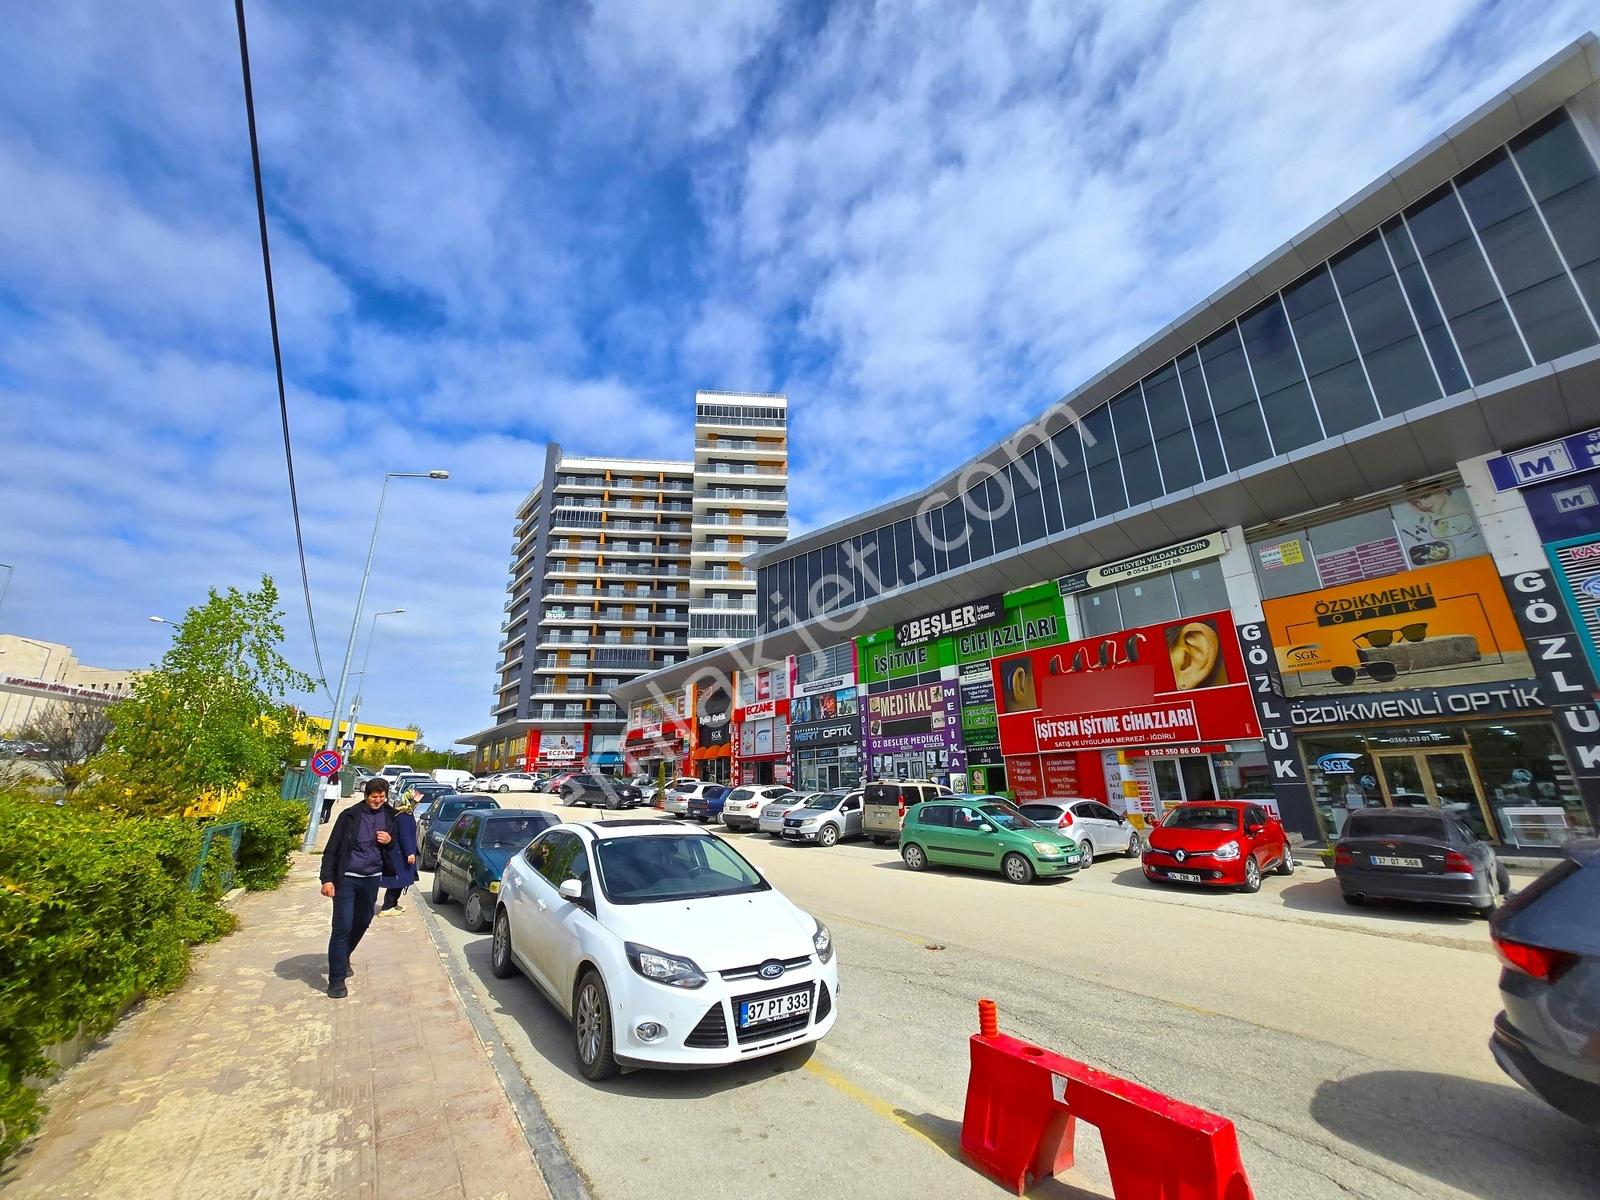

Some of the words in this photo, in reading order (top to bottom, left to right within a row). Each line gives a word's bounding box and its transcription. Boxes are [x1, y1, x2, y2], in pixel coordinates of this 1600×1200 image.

[1103, 558, 1146, 576] DİYETİSYEN
[1147, 550, 1177, 563] VİLDAN
[1178, 541, 1206, 555] ÖZDİN
[909, 605, 977, 638] BEŞLER
[960, 615, 1058, 655] CİHAZLARI
[900, 636, 929, 647] PEDİATRİK
[1294, 650, 1319, 661] SGK
[874, 646, 928, 675] İŞİTME
[758, 671, 770, 700] E
[746, 701, 774, 715] ECZANE
[1241, 624, 1298, 778] GÖZLÜK
[1291, 692, 1443, 726] ÖZDİKMENLİ
[1447, 683, 1545, 713] OPTİK
[1036, 719, 1079, 742] İŞİTSEN
[1079, 715, 1121, 738] İŞİTME
[1123, 708, 1194, 732] CİHAZLARI
[1081, 737, 1116, 746] UYGULAMA
[1116, 732, 1145, 743] MERKEZİ
[872, 739, 881, 748] ÖZ
[883, 737, 909, 748] BEŞLER
[911, 733, 944, 745] MEDİKAL
[1322, 759, 1353, 771] SGK
[748, 1002, 765, 1020] 37
[768, 998, 784, 1016] PT
[786, 993, 808, 1011] 333
